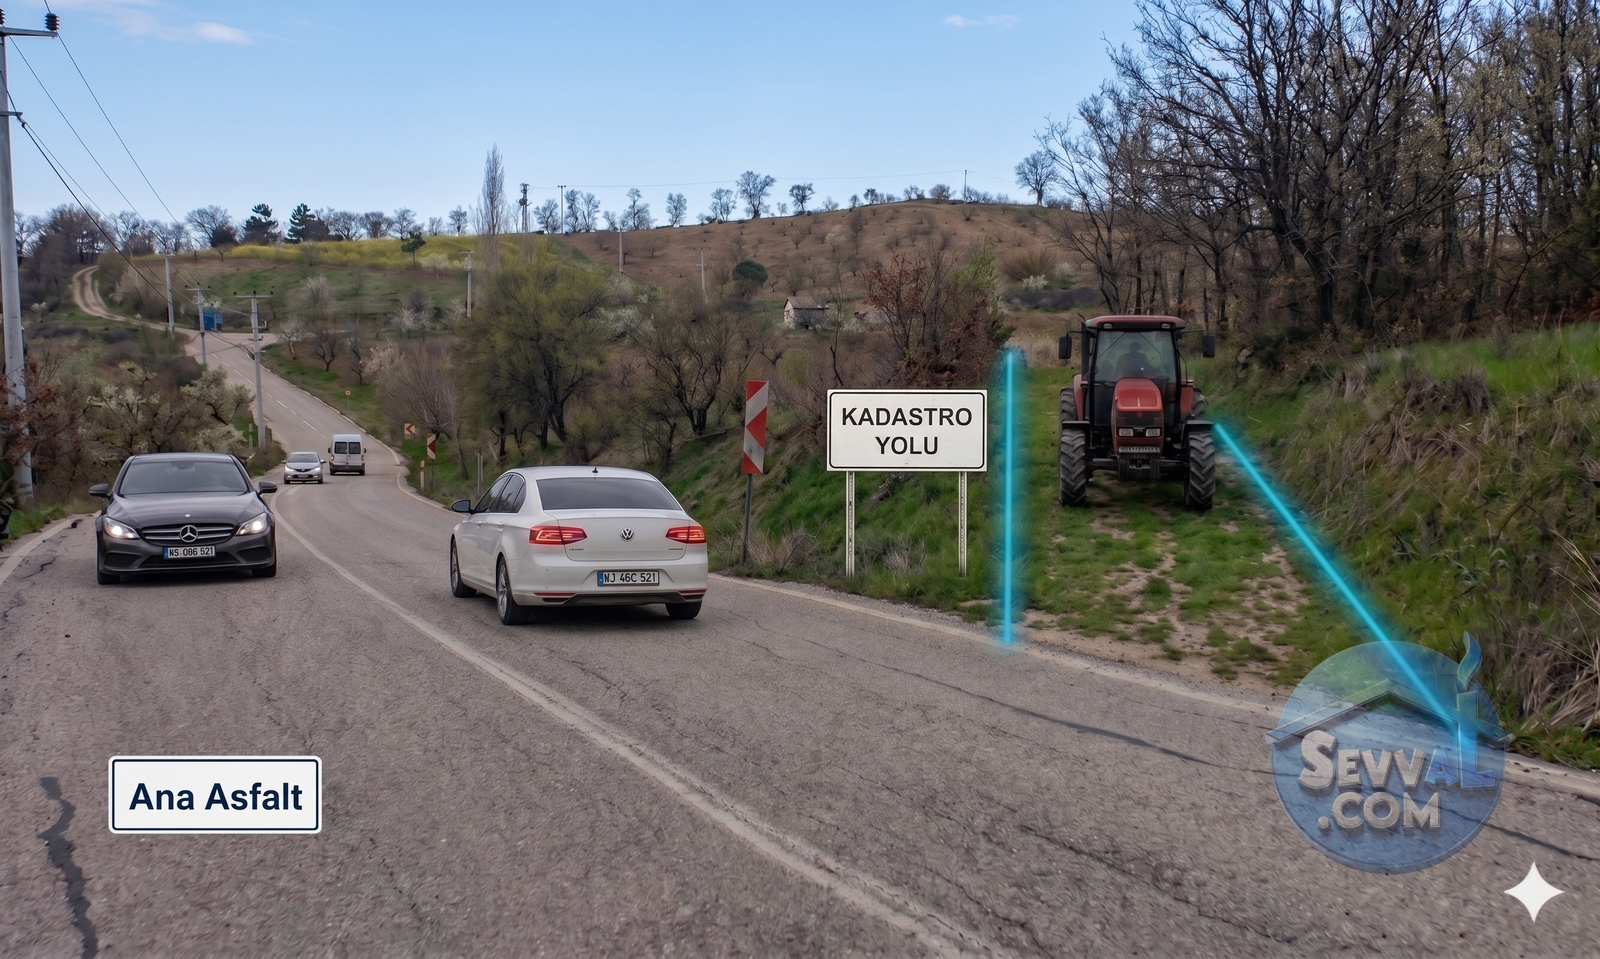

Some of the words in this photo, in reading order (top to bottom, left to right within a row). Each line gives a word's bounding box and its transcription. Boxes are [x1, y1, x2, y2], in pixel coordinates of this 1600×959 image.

[842, 407, 973, 427] KADASTRO
[875, 436, 939, 455] YOLU
[169, 548, 179, 557] NS
[183, 548, 198, 556] 086
[200, 547, 214, 556] 521
[604, 572, 616, 583] NJ
[619, 572, 637, 583] 46C
[640, 572, 656, 583] 521
